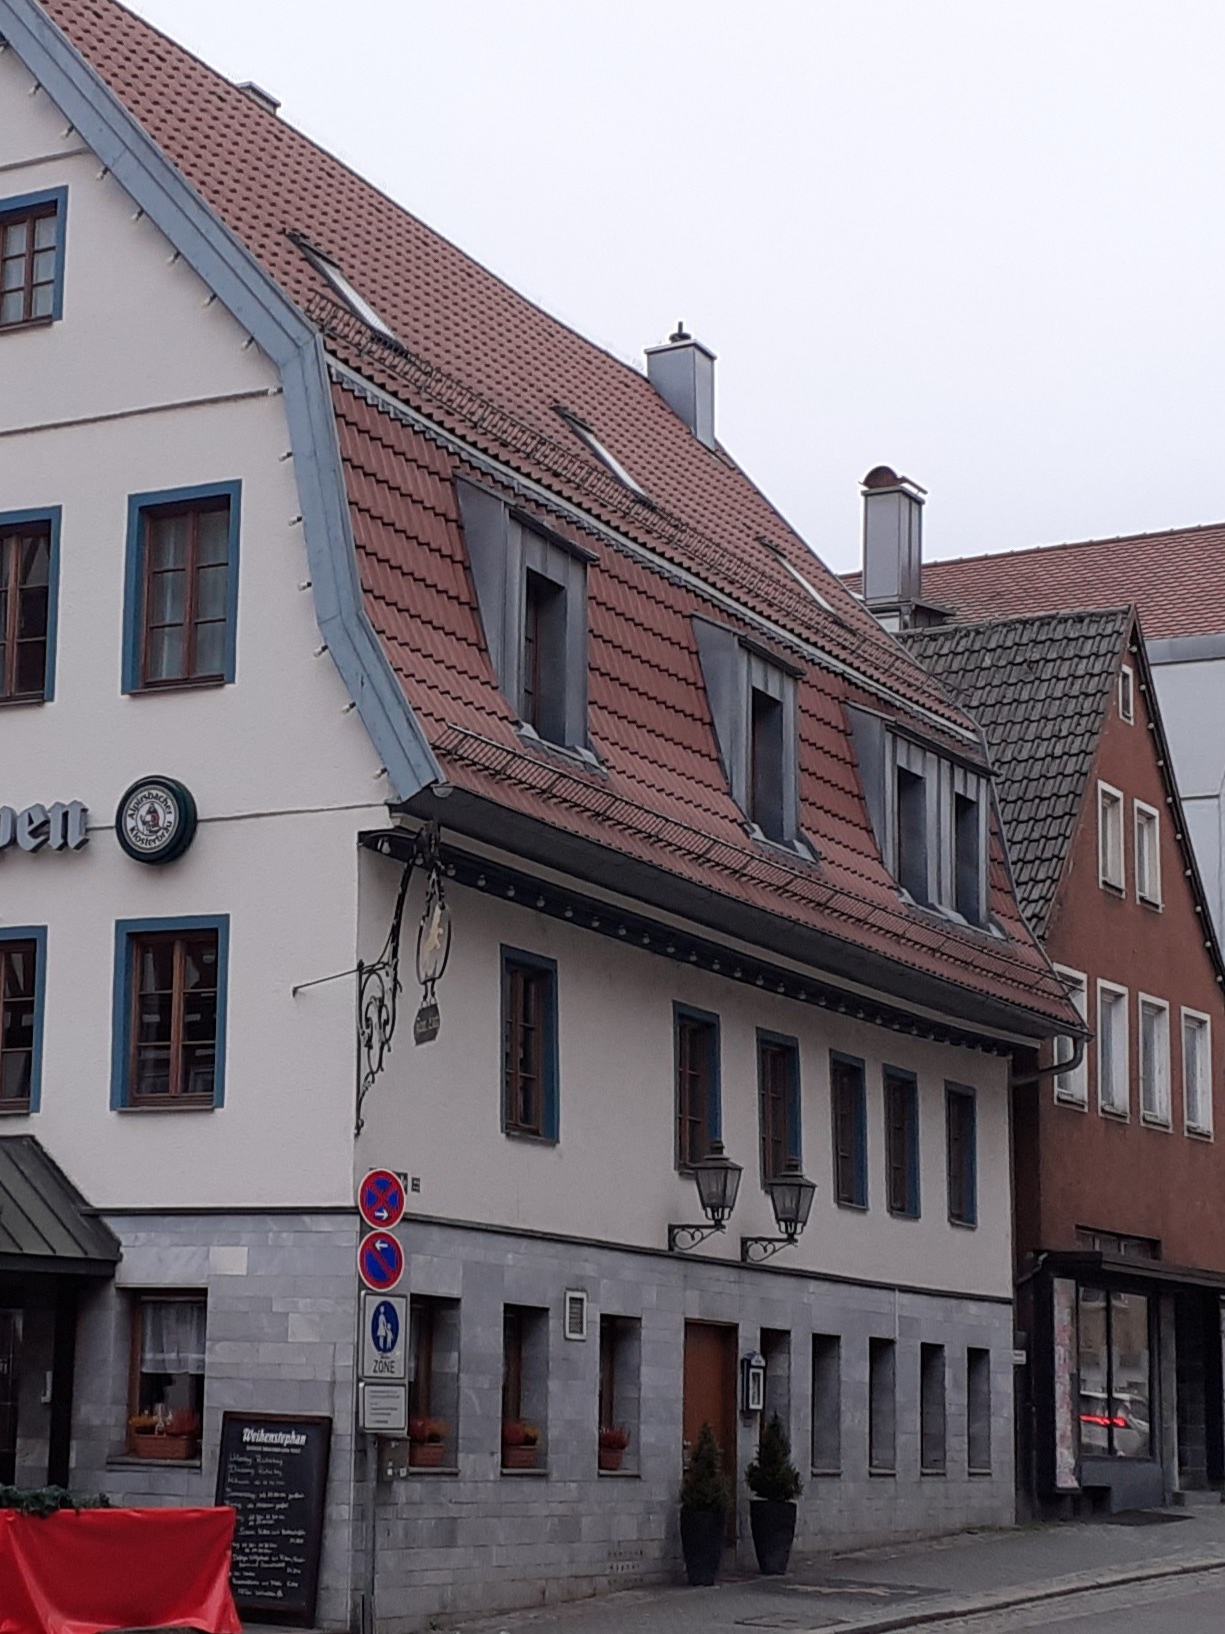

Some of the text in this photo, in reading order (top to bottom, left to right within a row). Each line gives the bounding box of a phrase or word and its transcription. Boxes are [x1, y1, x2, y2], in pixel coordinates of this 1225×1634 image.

[128, 791, 173, 820] Alpirsbacher
[372, 1360, 396, 1374] ZONE
[242, 1427, 307, 1447] Weihenstephan
